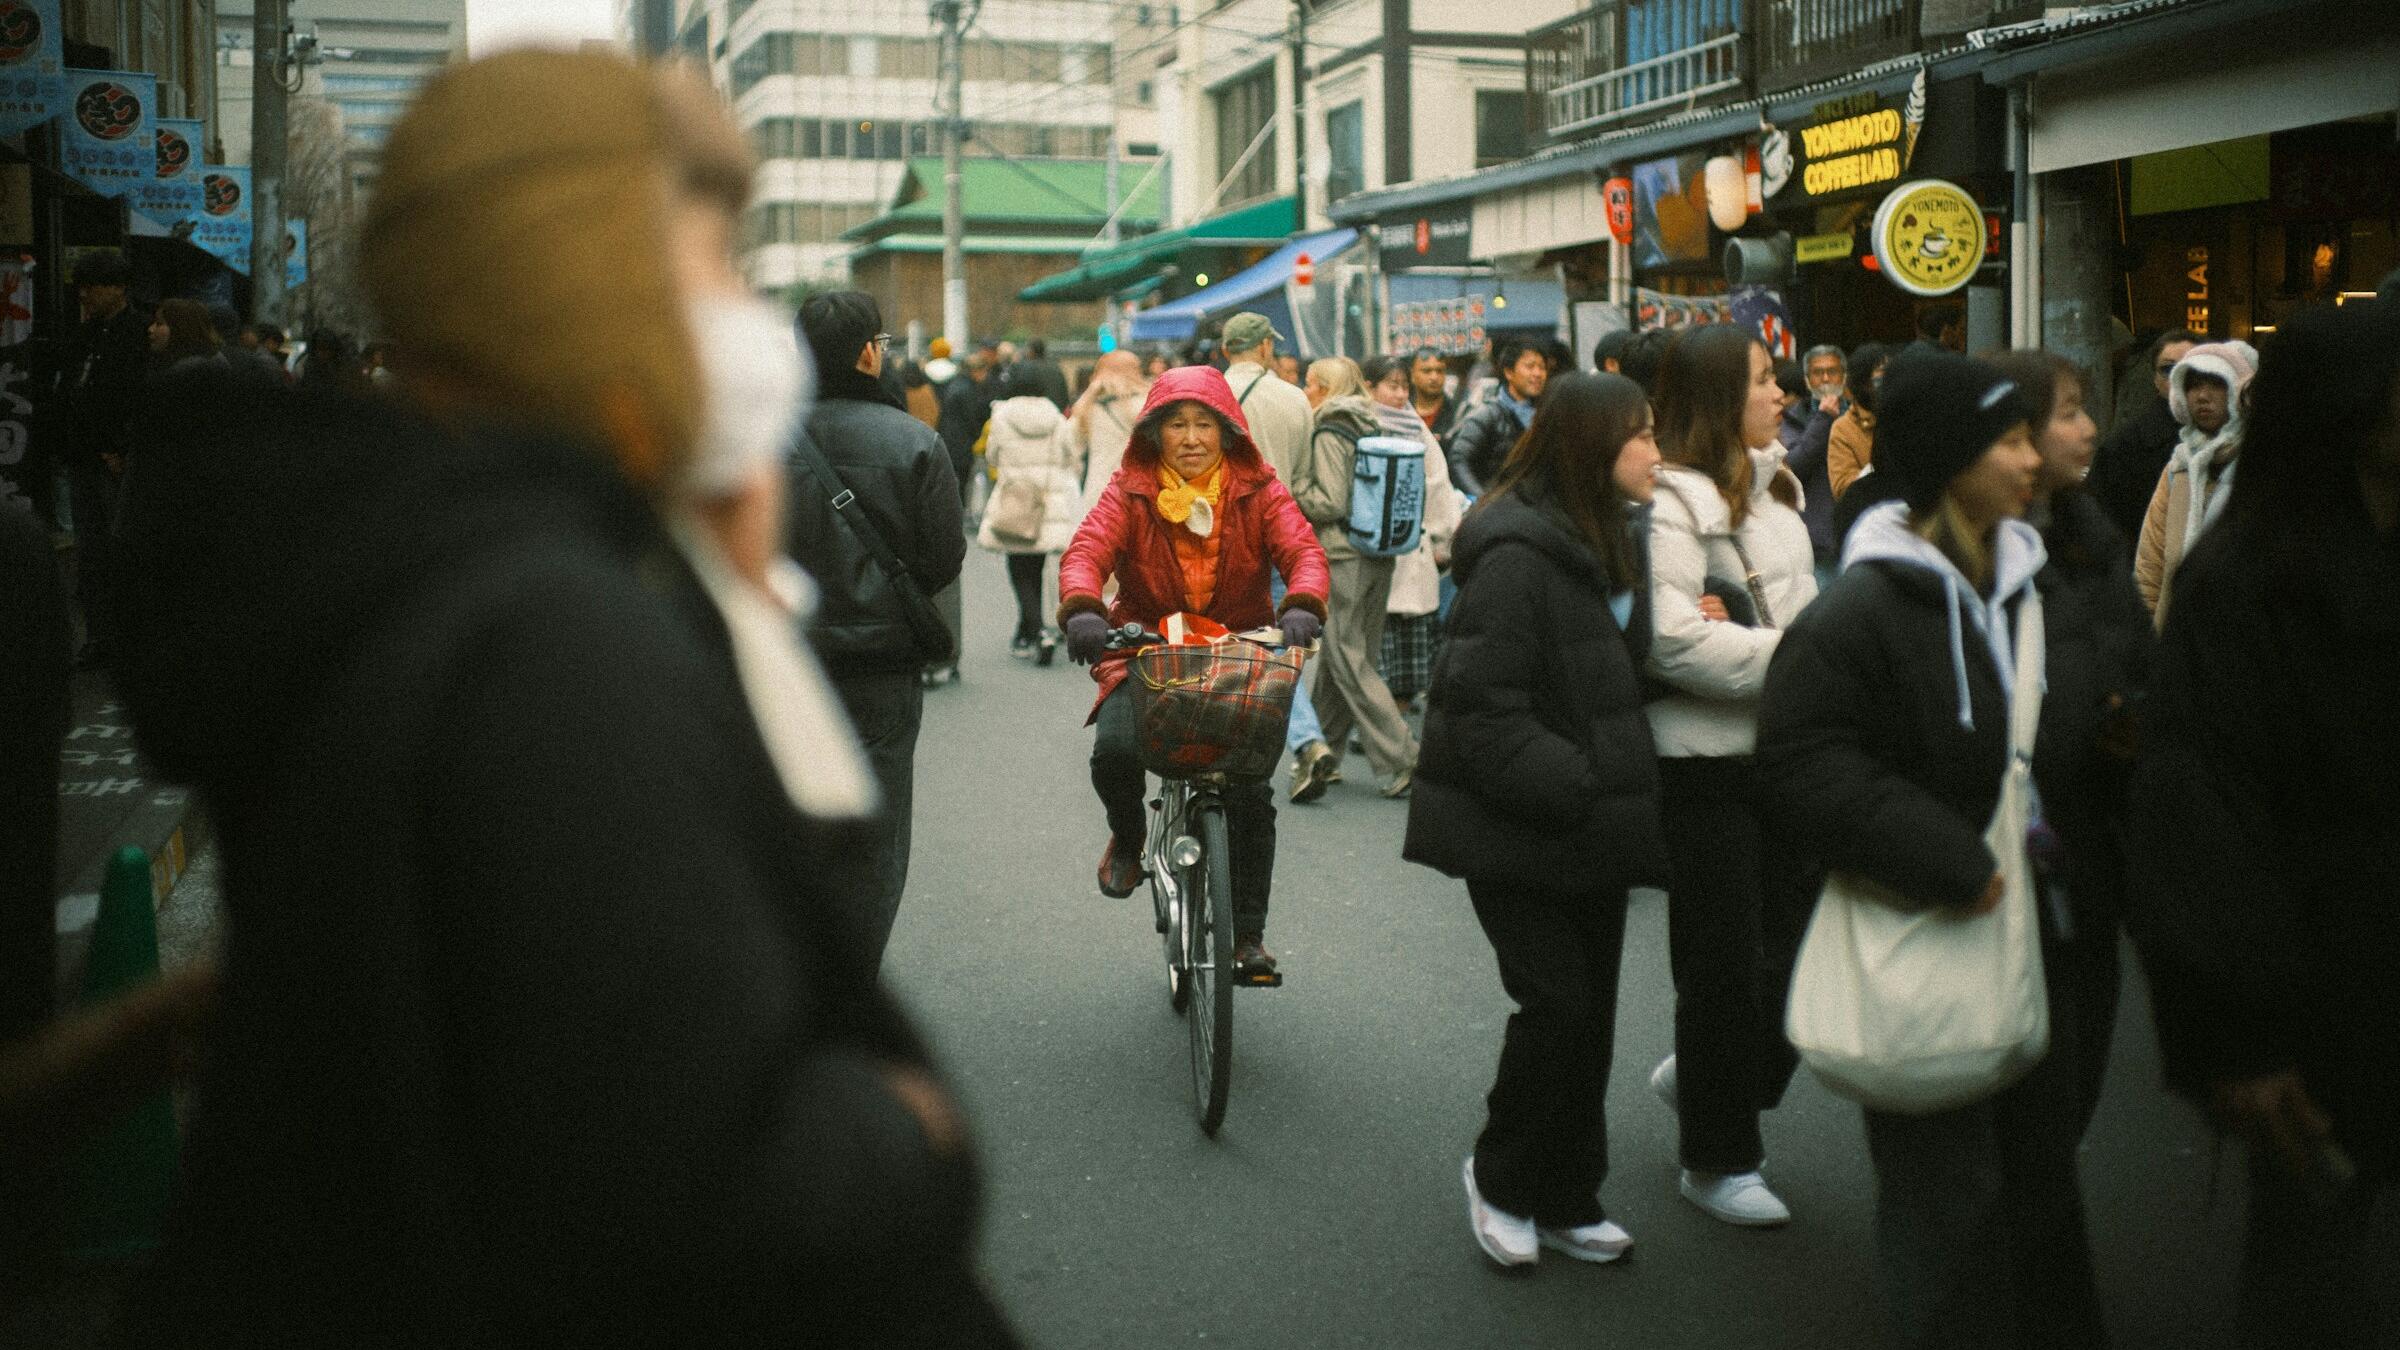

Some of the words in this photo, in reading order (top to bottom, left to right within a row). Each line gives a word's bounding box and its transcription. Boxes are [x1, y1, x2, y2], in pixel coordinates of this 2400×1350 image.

[1801, 108, 1899, 159] YONEMOTO
[1804, 155, 1861, 196] COFFEE
[1860, 148, 1899, 185] LAB
[1913, 199, 1960, 213] YONEMOTO
